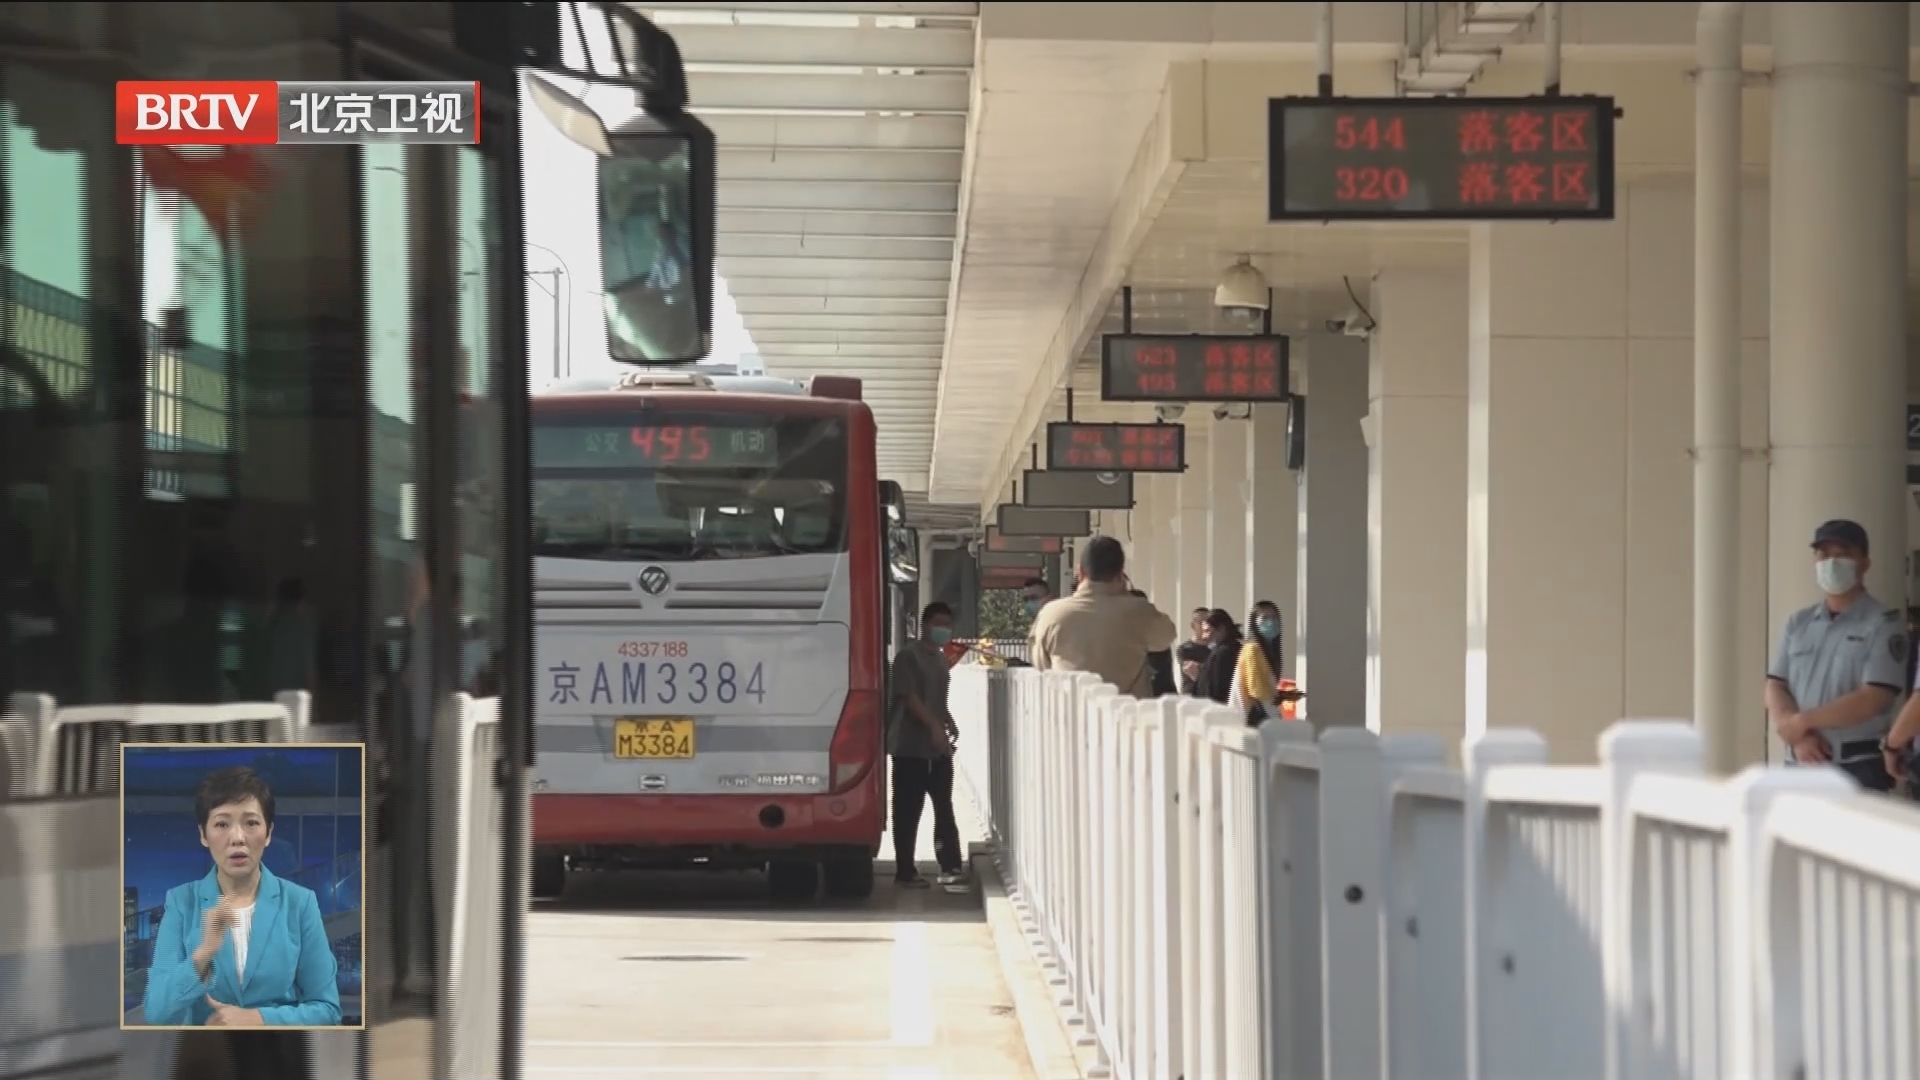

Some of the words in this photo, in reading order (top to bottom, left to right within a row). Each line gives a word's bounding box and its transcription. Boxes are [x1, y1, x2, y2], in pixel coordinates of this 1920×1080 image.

[1335, 115, 1406, 150] 544
[1458, 109, 1590, 153] 落客区
[1335, 166, 1409, 201] 320
[1458, 160, 1590, 204] 落客区
[584, 431, 620, 453] 公交
[631, 425, 712, 461] 495
[730, 429, 765, 453] 机动
[617, 642, 688, 657] 4337188
[618, 734, 689, 755] M3384
